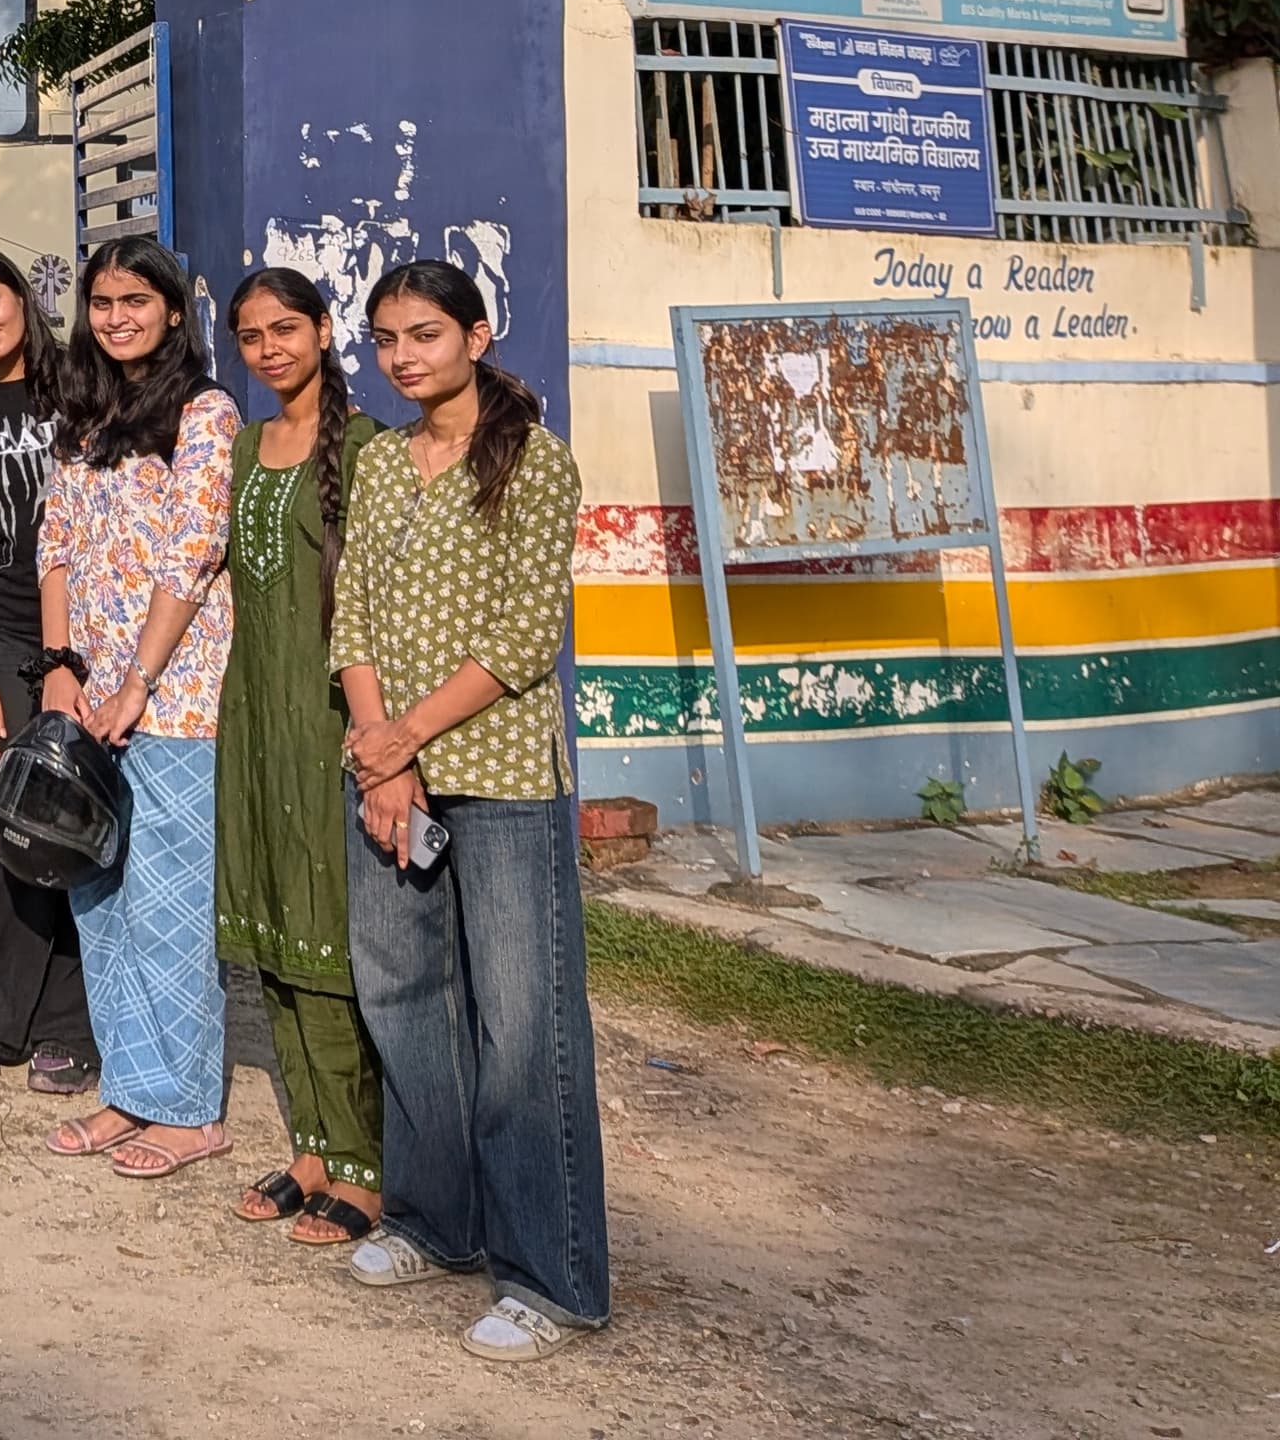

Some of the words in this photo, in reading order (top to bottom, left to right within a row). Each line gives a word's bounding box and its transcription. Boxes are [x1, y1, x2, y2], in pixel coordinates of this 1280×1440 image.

[870, 72, 914, 94] विद्यालय
[807, 106, 870, 133] महात्मा
[871, 107, 909, 136] गांधी
[910, 111, 971, 140] राजकीय
[806, 137, 840, 160] उच्च
[841, 136, 920, 166] माध्यमिक
[922, 140, 980, 170] विद्यालय
[873, 247, 953, 299] Today
[967, 263, 982, 289] a
[1003, 254, 1094, 293] Reader
[1025, 313, 1040, 340] a
